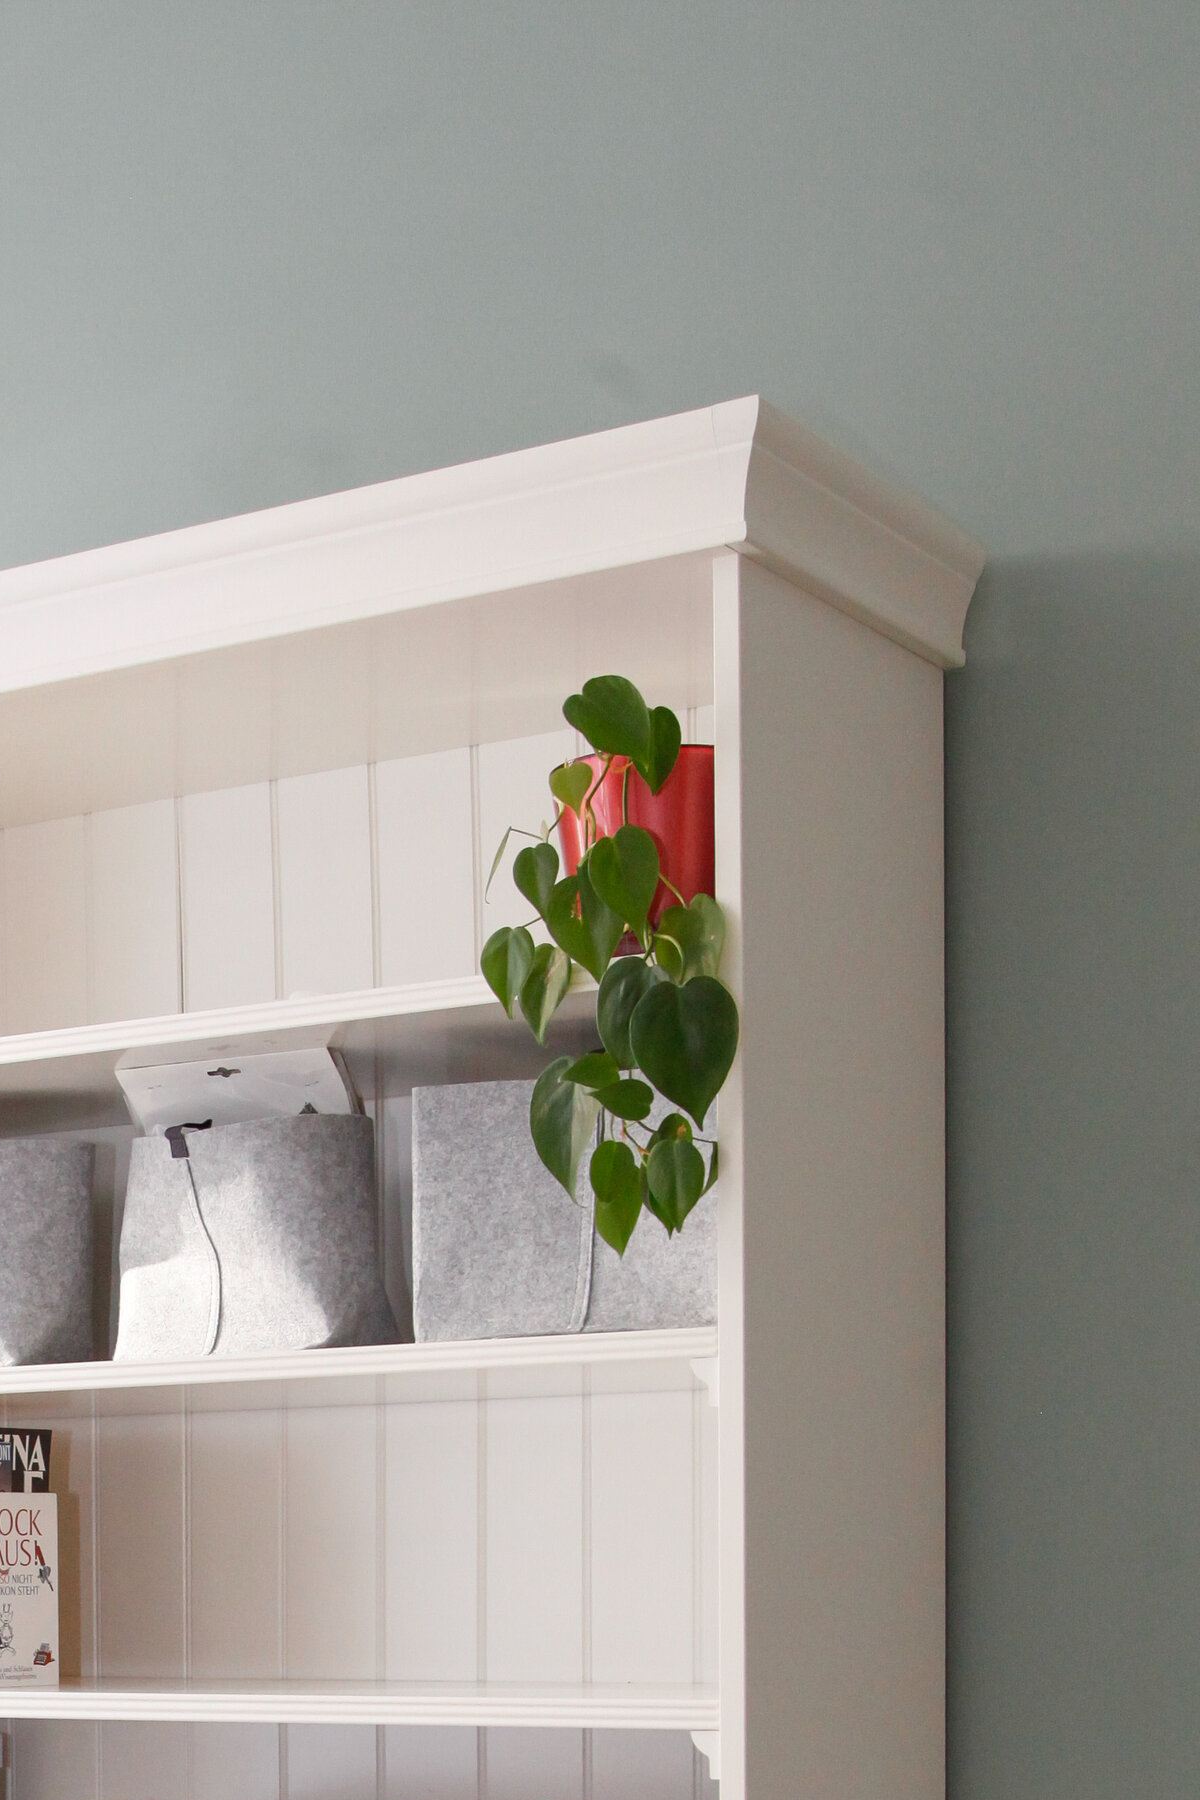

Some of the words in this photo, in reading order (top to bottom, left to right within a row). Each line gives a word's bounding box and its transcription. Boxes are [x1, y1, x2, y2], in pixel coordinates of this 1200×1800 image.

[0, 1574, 10, 1584] SO
[11, 1574, 33, 1584] NICHT
[17, 1585, 40, 1596] STEHT
